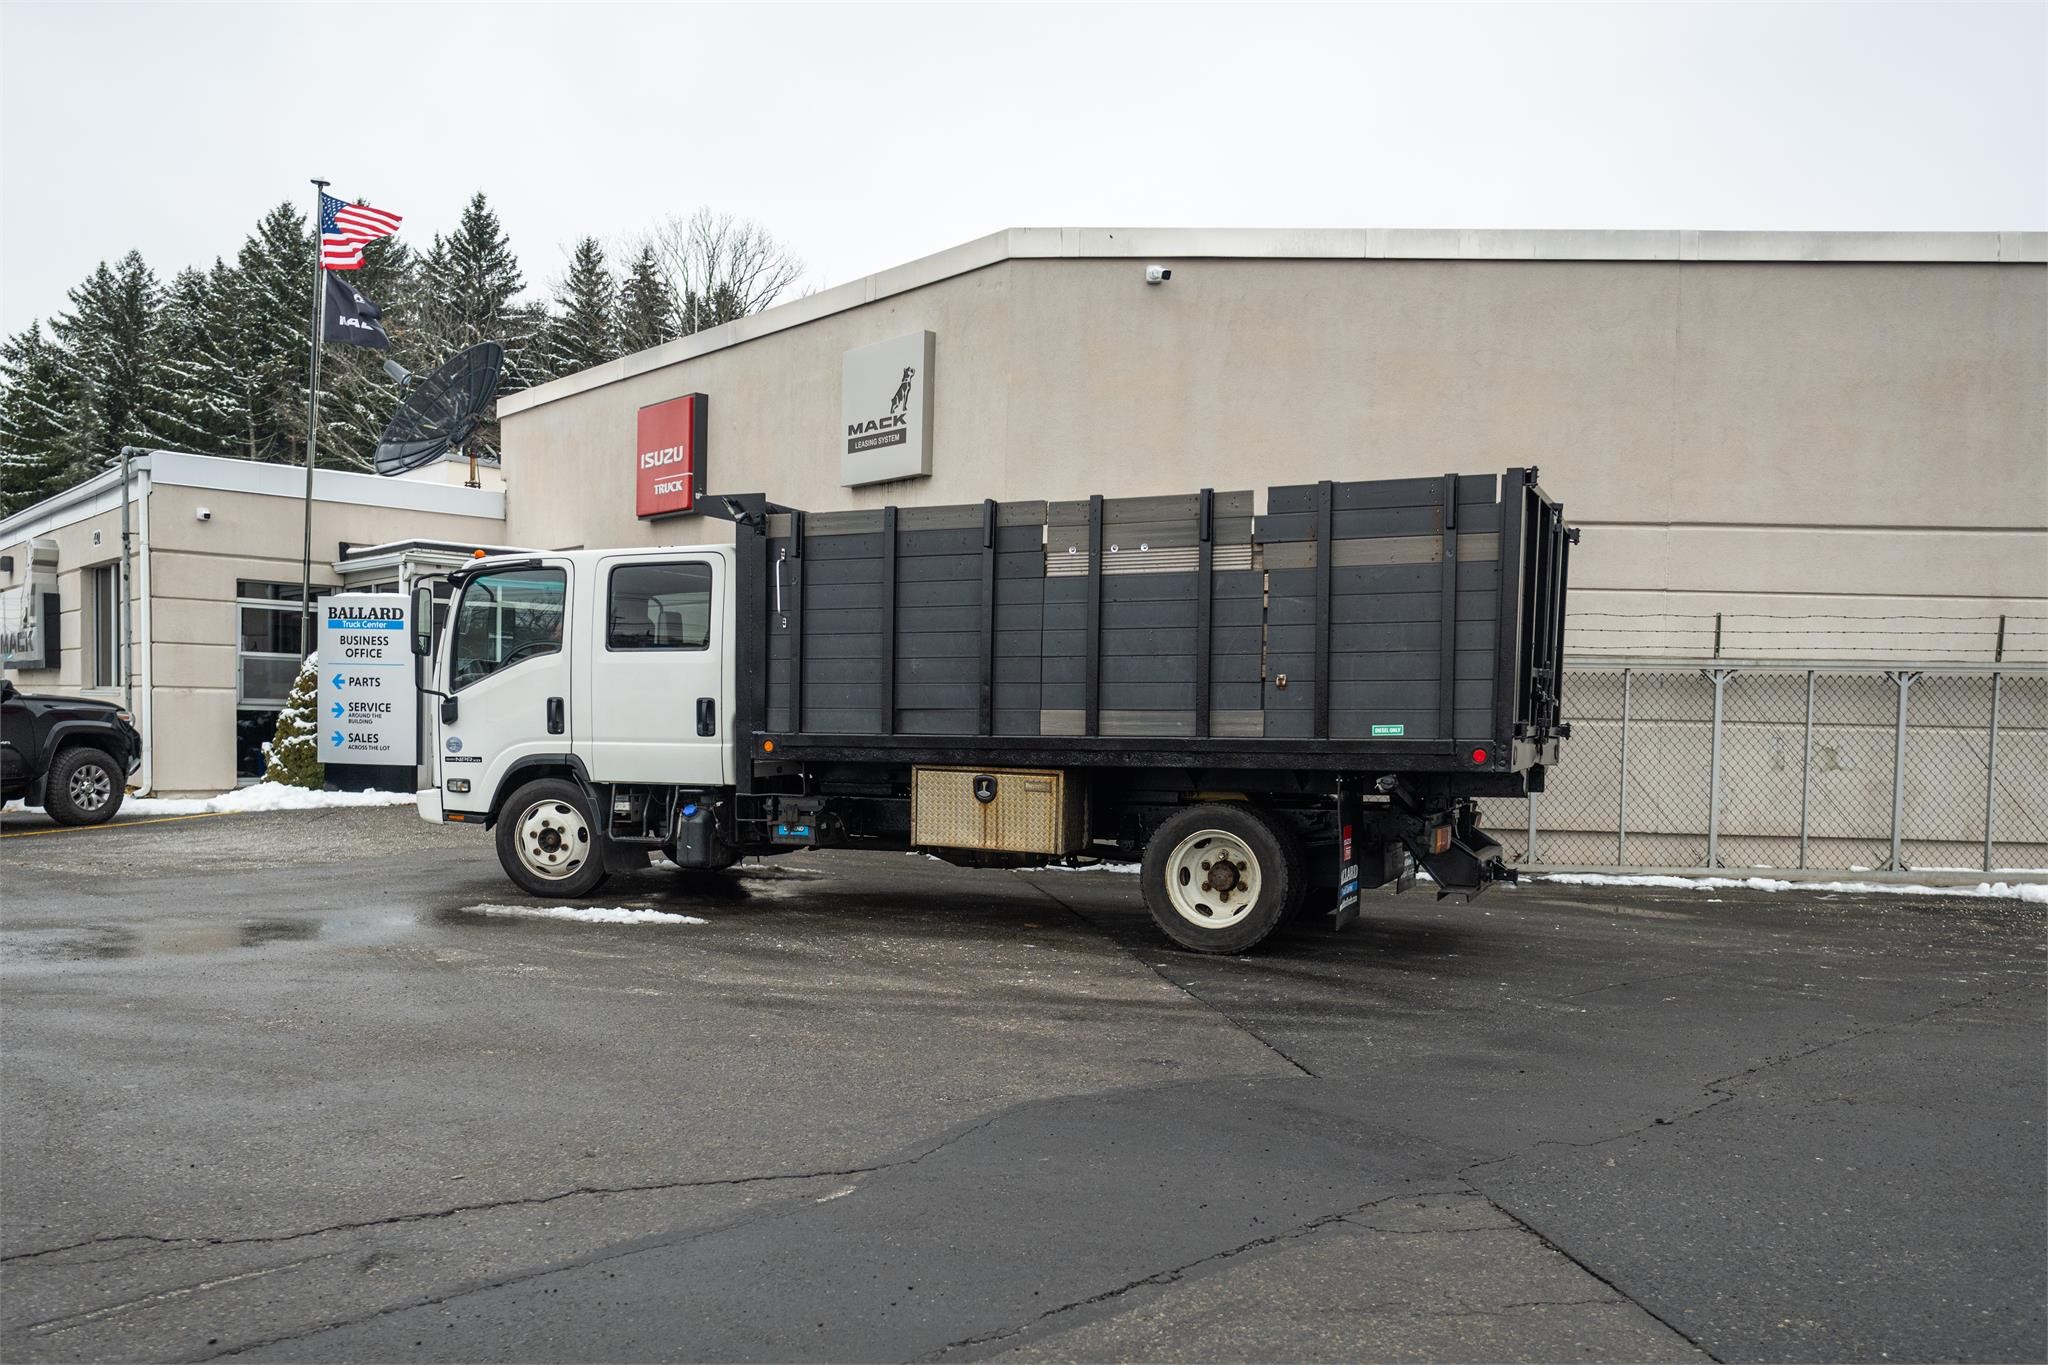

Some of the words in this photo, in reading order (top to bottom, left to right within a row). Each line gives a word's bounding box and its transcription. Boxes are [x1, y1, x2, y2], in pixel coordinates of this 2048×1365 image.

[848, 413, 907, 437] MACK
[855, 438, 878, 450] LEASING
[878, 433, 900, 446] SYSTEM
[640, 445, 684, 469] ISUZU
[653, 479, 683, 495] TRUCK
[328, 606, 404, 620] BALLARD
[342, 620, 361, 628] Truck
[362, 620, 387, 629] Center
[340, 635, 389, 646] BUSINESS
[345, 648, 382, 659] OFFICE
[348, 677, 381, 687] PARTS
[348, 702, 391, 713] SERVICE
[348, 733, 379, 743] SALES
